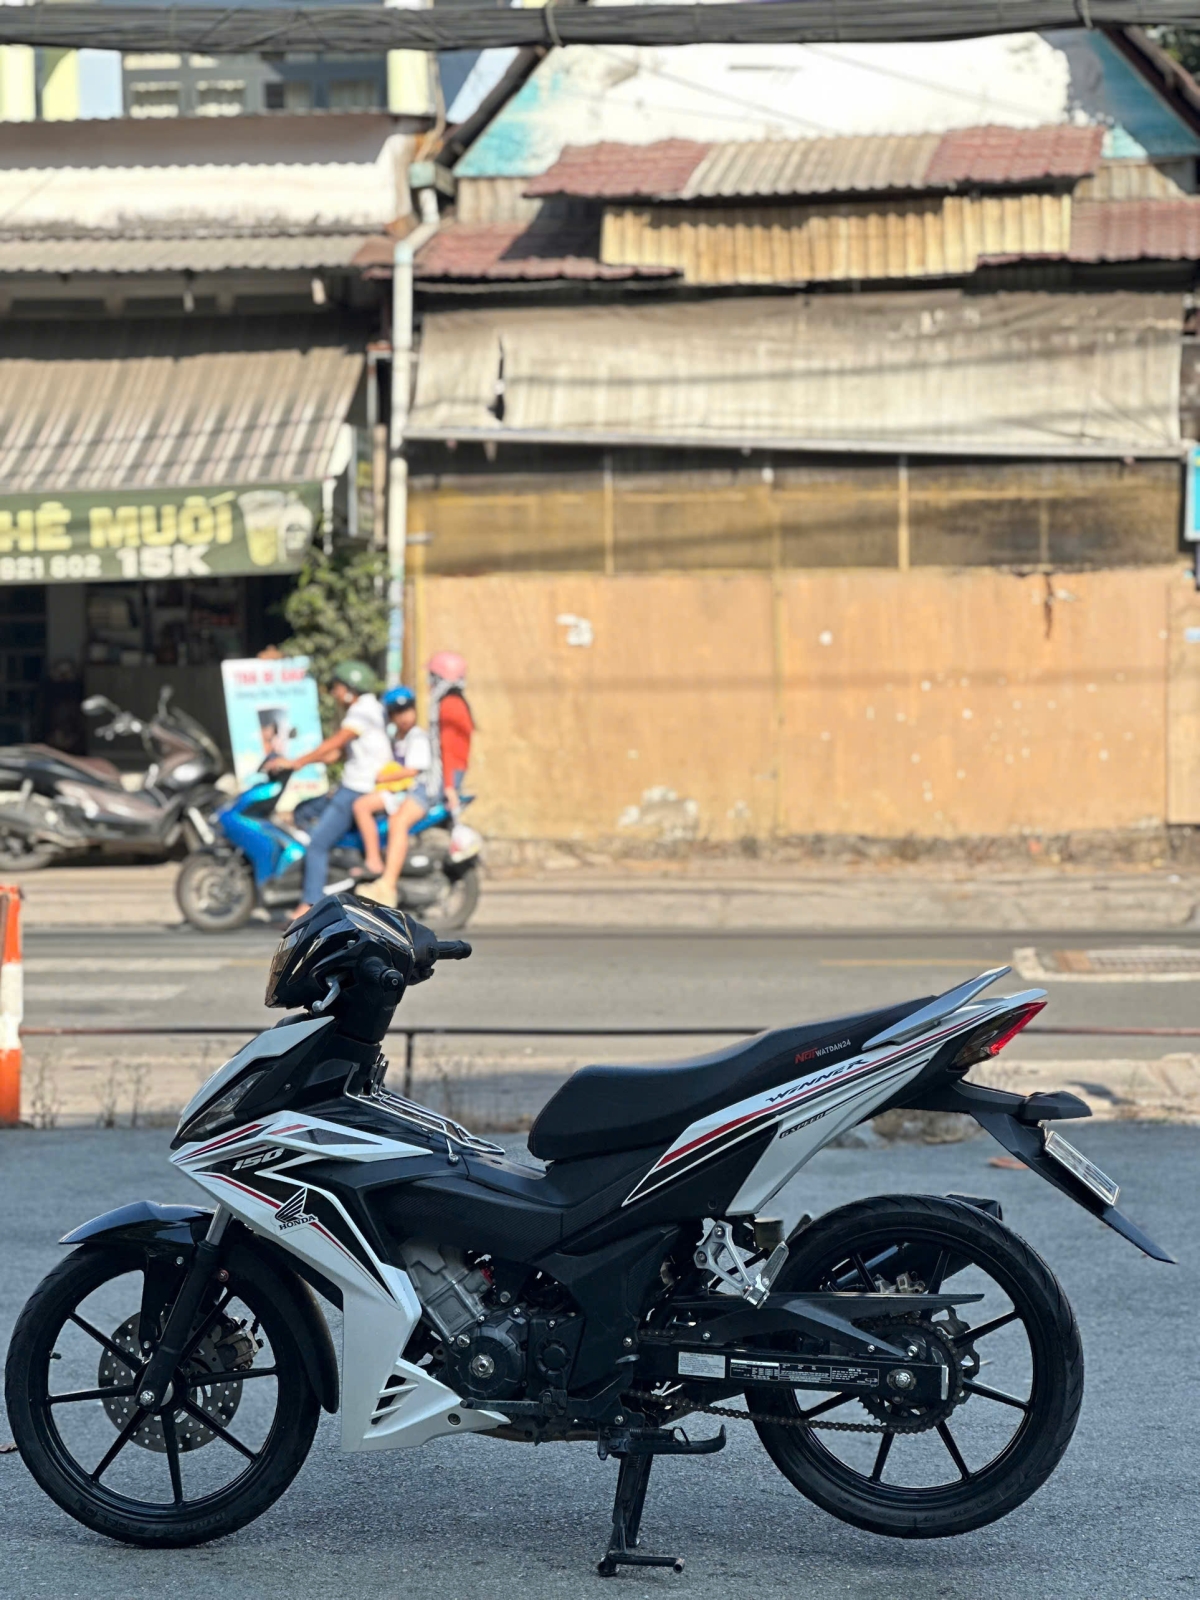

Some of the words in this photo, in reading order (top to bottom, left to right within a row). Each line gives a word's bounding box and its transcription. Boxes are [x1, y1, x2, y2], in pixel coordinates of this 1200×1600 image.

[116, 543, 211, 579] 15K
[765, 1059, 870, 1102] WINNER
[232, 1146, 286, 1171] 150
[279, 1214, 317, 1231] HONDA
